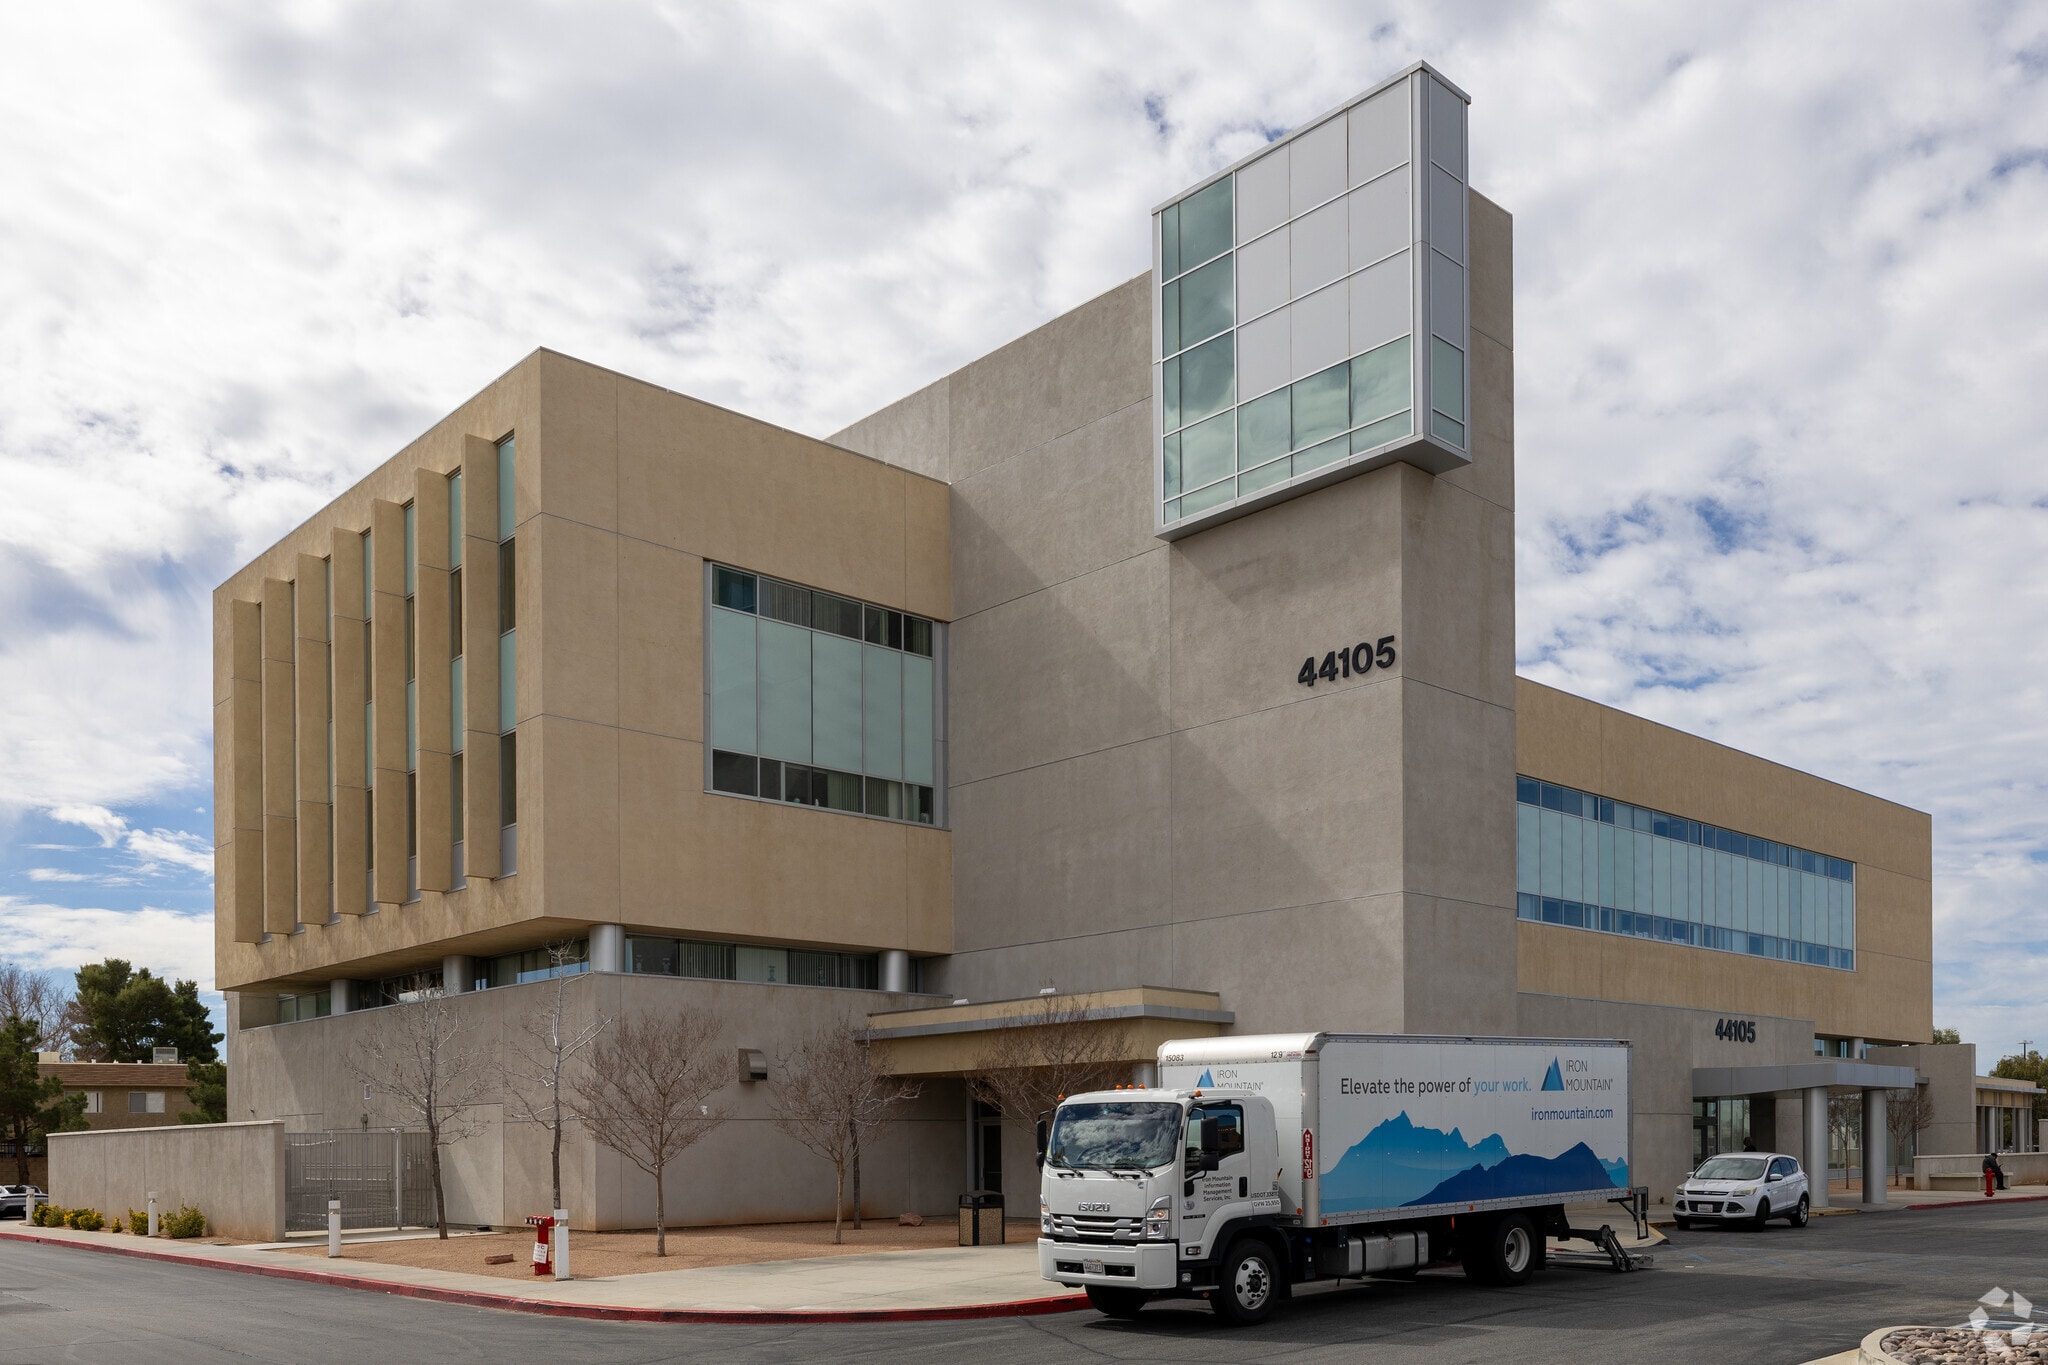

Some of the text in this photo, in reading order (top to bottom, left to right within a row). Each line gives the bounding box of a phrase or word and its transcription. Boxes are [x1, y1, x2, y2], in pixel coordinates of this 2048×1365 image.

[1297, 635, 1396, 687] 44105
[1715, 1018, 1757, 1044] 44105
[1565, 1060, 1588, 1073] IRON
[1216, 1069, 1238, 1079] IRON
[1217, 1082, 1262, 1090] MOUNTAIN
[1341, 1077, 1532, 1097] Elevate the power of your work.
[1566, 1079, 1612, 1091] MOUNTAIN
[1531, 1106, 1613, 1121] ironmountain.com
[1078, 1202, 1111, 1212] ISUZU
